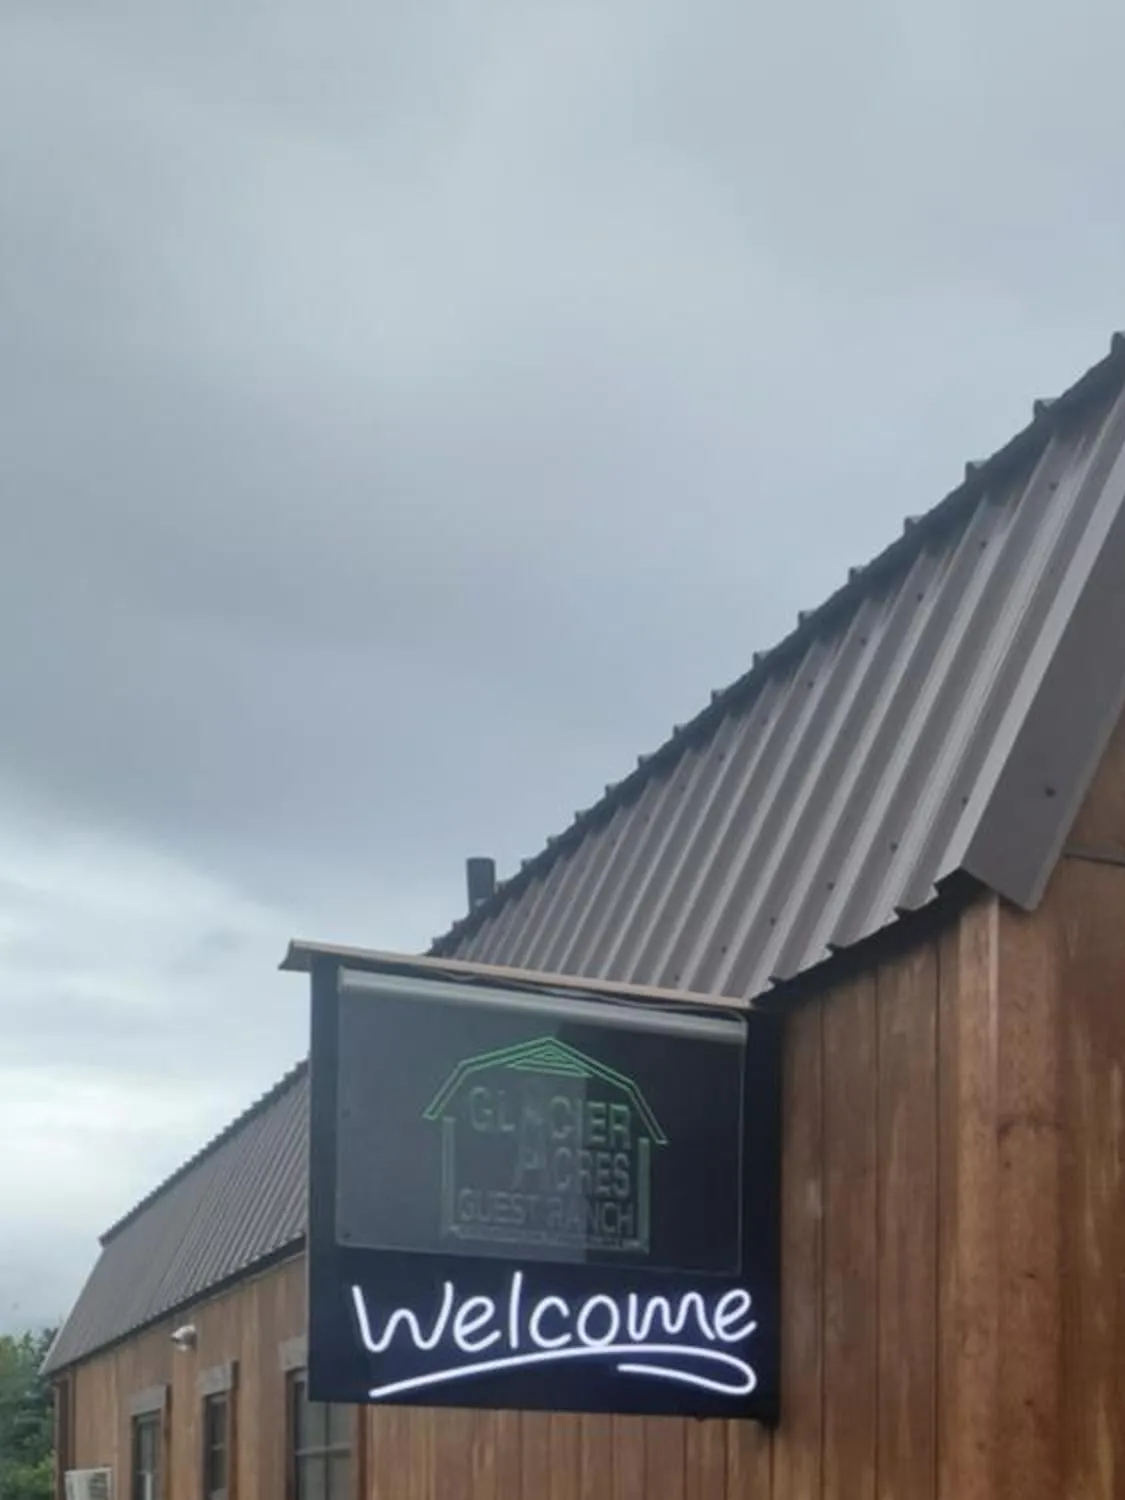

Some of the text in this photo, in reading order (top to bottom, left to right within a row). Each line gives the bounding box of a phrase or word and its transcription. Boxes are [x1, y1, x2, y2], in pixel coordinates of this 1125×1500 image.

[457, 1187, 635, 1239] GUEST RANCH
[350, 1270, 758, 1354] Welcome
